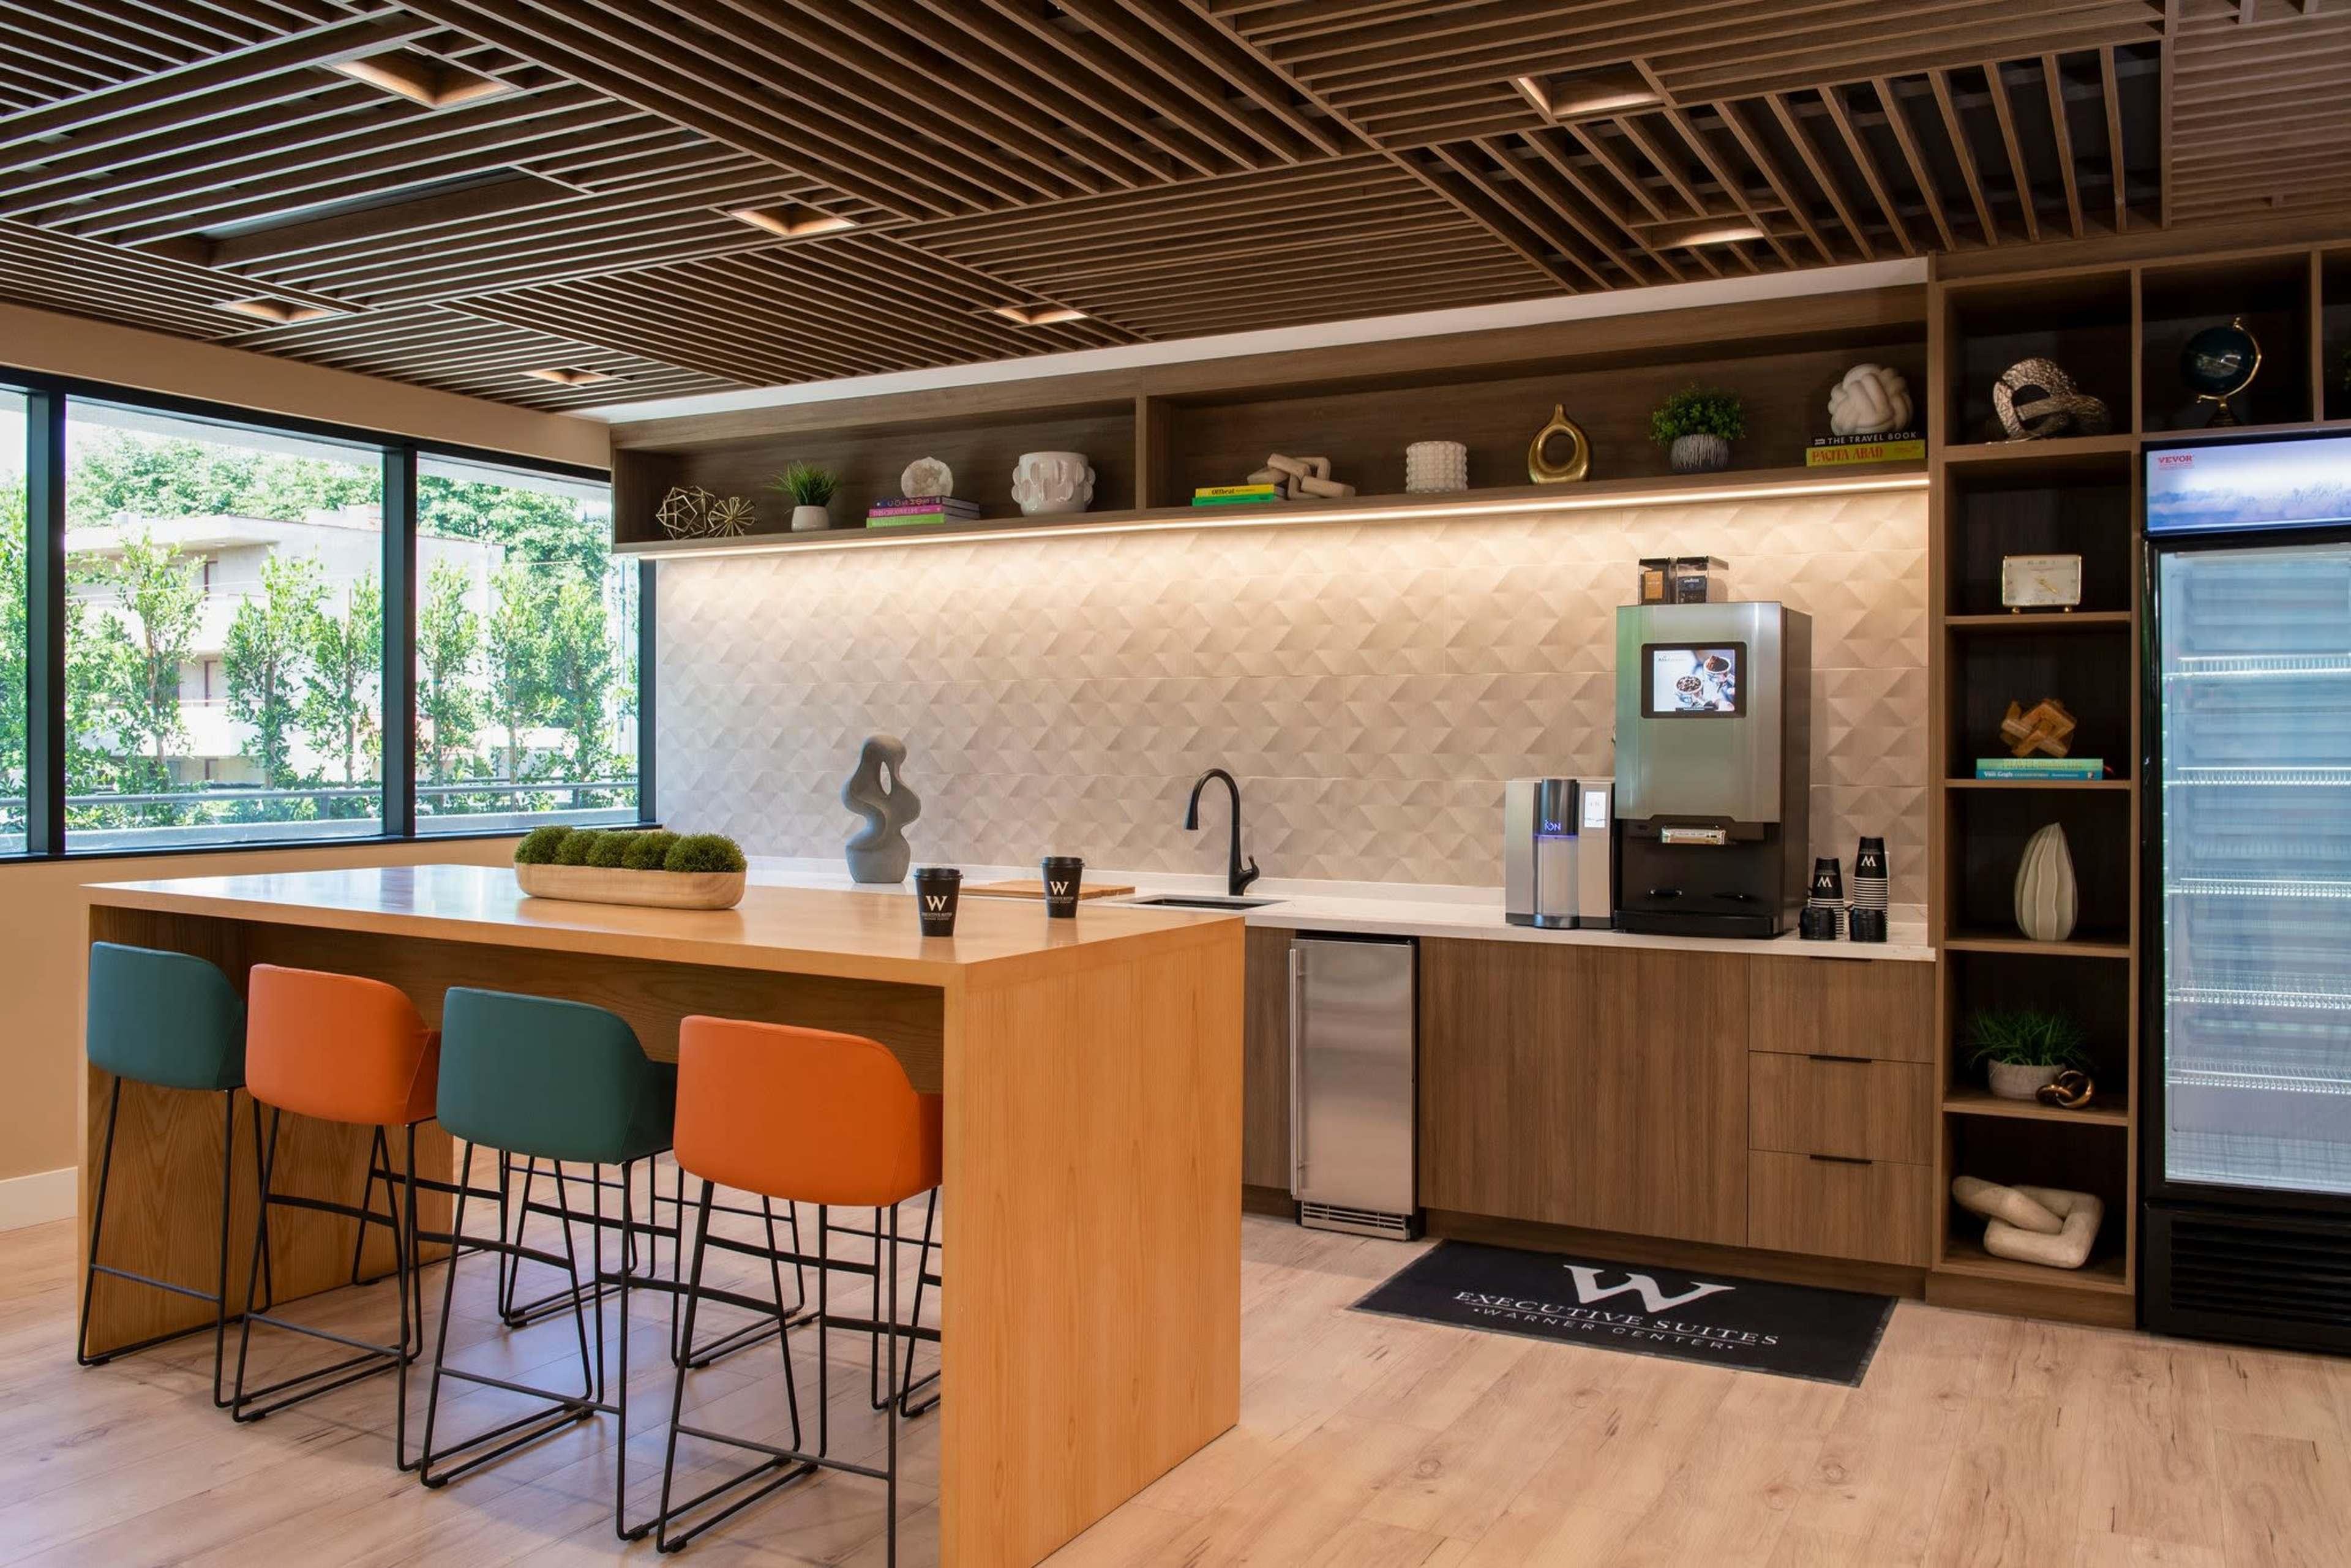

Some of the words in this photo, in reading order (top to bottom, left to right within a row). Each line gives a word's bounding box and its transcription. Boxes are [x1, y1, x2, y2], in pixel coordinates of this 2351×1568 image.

[1828, 436, 1845, 445] THE
[1850, 433, 1884, 443] TRAVEL
[1888, 431, 1917, 440] BOOK
[2158, 455, 2192, 463] VEVOR
[1049, 880, 1069, 895] W
[925, 895, 948, 912] W
[1564, 1264, 1736, 1313] W
[1453, 1291, 1643, 1326] EXECUTIVE
[1653, 1319, 1779, 1345] SUITES
[1483, 1308, 1595, 1331] WARNER
[1612, 1327, 1724, 1349] CENTER
